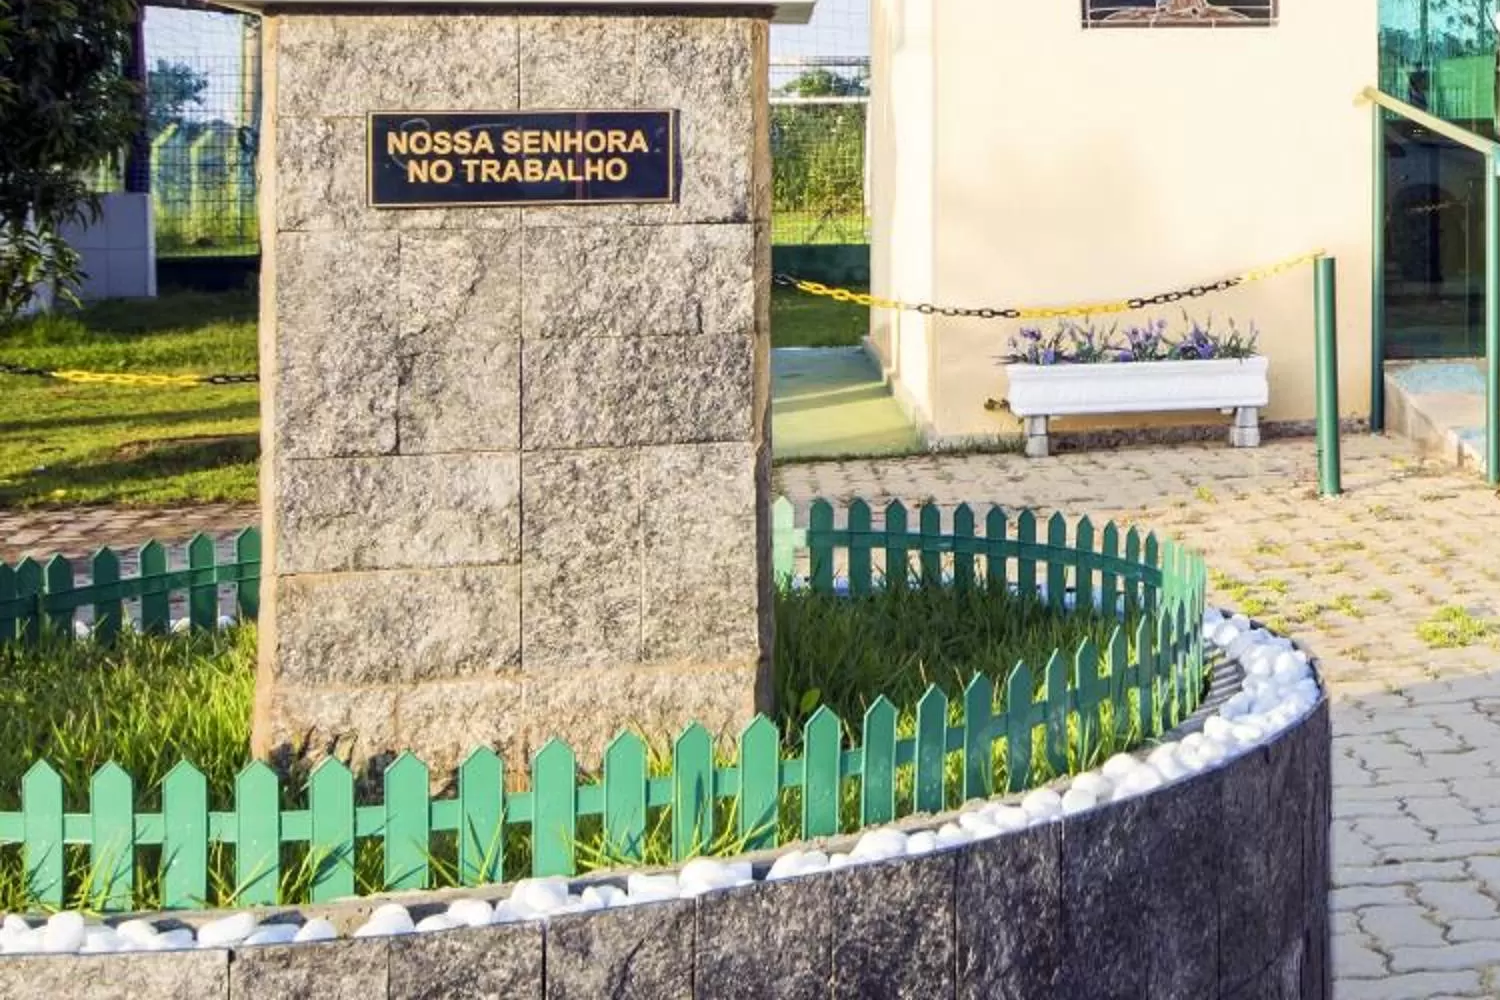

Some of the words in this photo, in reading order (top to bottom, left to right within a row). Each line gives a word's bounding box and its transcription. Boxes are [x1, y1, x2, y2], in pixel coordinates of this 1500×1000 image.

[387, 131, 494, 155] NOSSA
[502, 130, 649, 153] SENHORA
[407, 160, 453, 183] NO
[461, 159, 628, 182] TRABALHO
